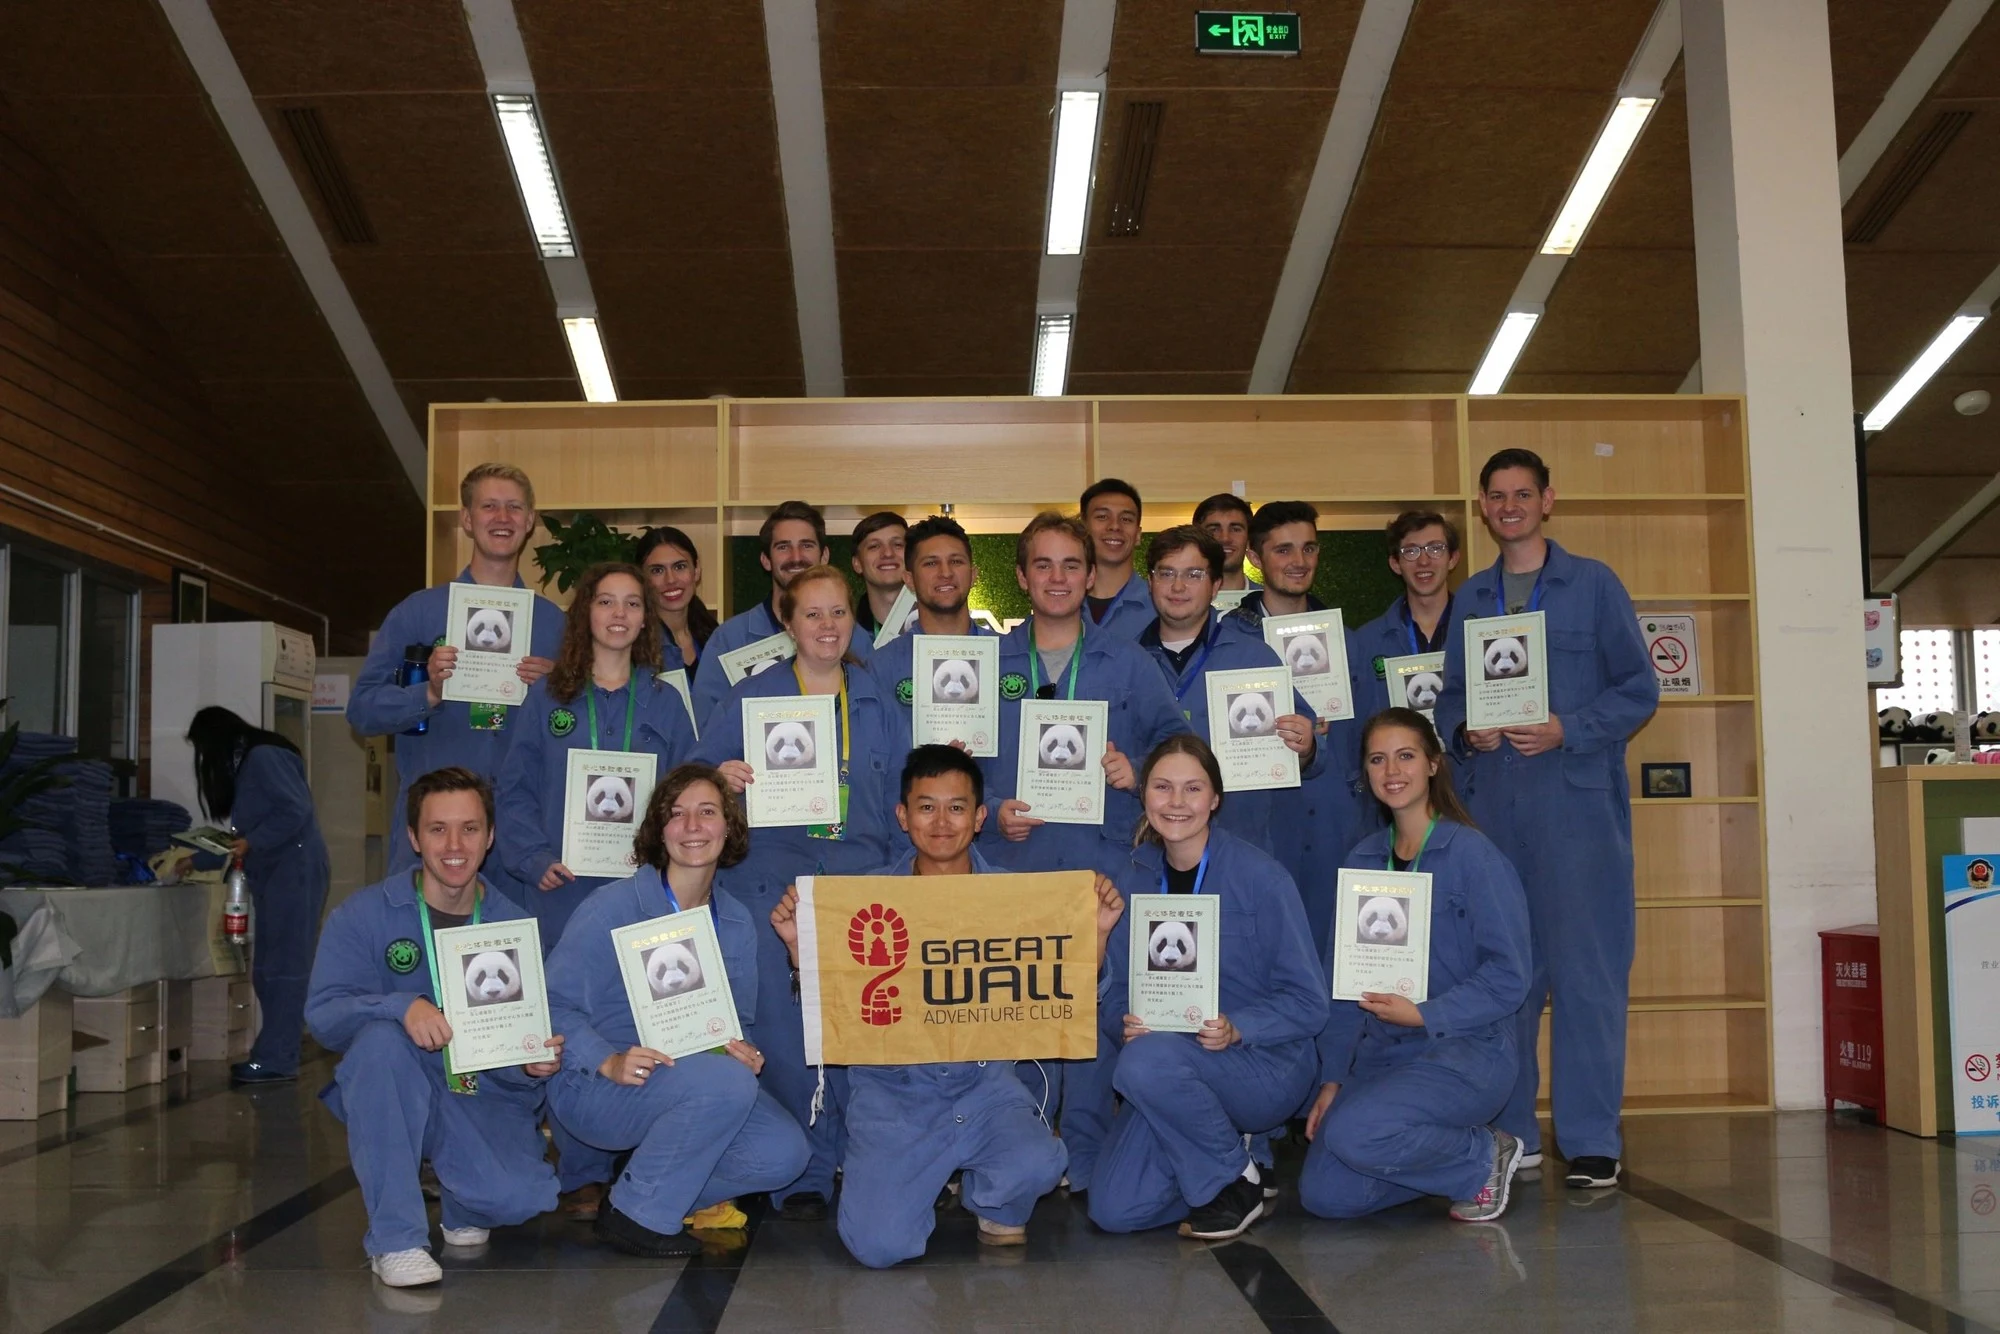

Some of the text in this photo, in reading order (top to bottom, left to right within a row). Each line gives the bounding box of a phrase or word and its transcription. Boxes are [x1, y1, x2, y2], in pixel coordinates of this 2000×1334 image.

[921, 934, 1073, 965] GREAT
[1835, 962, 1868, 979] 灭火器箱
[922, 964, 1074, 1005] WALL
[923, 1004, 1073, 1024] ADVENTURE CLUB
[1857, 1044, 1872, 1062] 119
